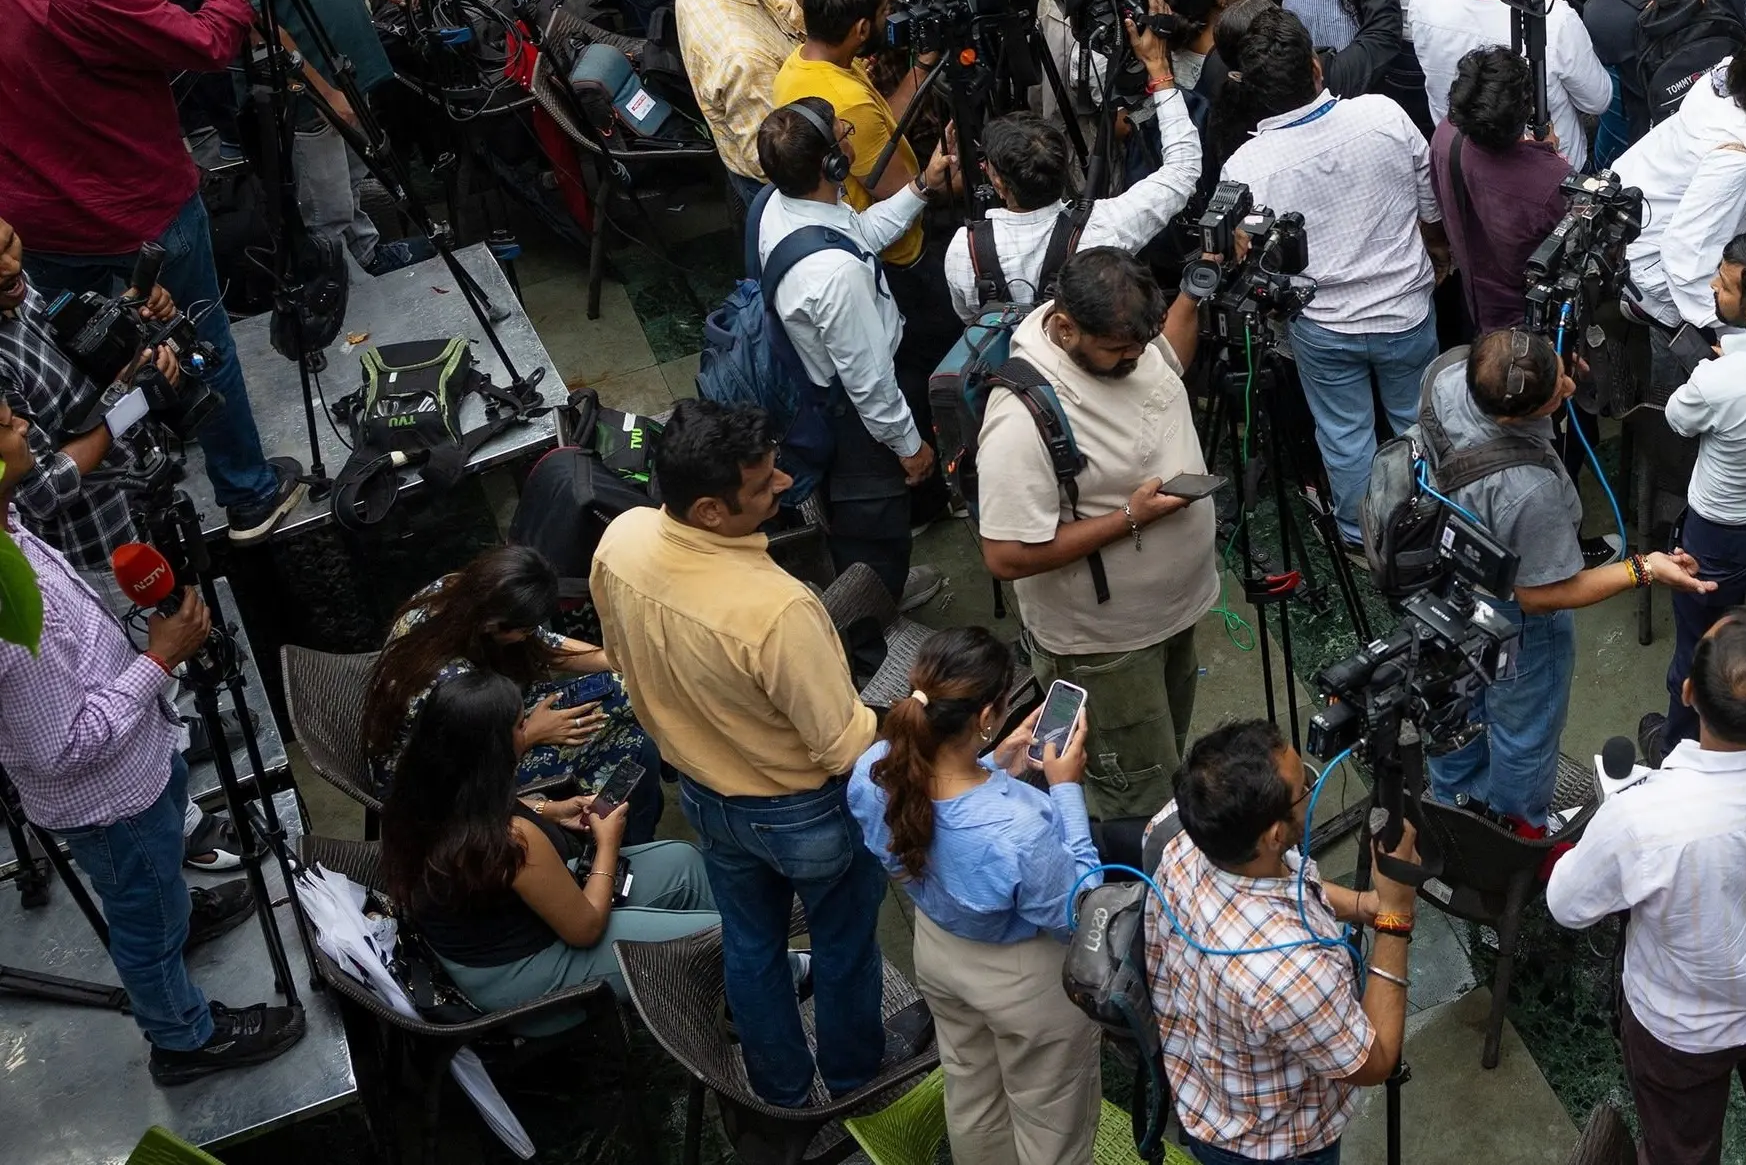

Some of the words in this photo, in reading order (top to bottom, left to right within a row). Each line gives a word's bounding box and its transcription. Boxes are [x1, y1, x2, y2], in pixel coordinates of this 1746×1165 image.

[1665, 75, 1693, 97] TOMMY
[388, 415, 417, 429] TVU
[630, 428, 643, 450] TVU
[132, 564, 166, 593] NDTV
